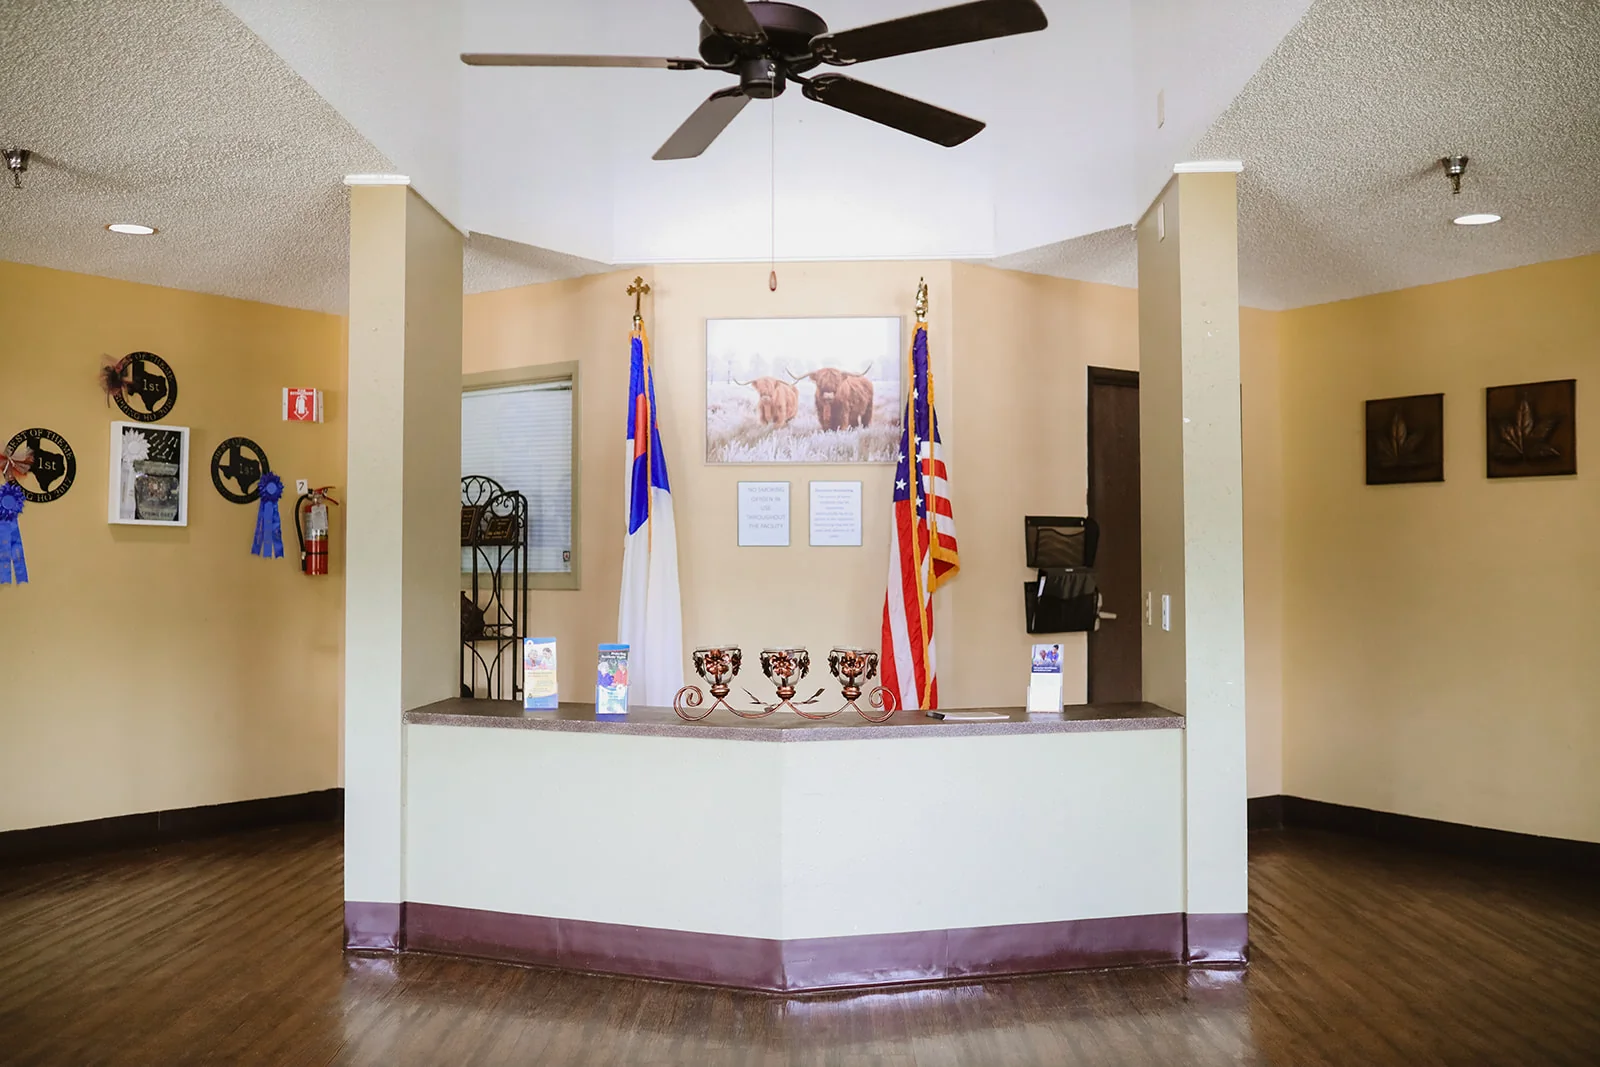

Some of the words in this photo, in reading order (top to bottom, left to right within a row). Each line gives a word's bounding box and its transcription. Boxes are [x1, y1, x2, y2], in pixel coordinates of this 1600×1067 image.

[143, 379, 160, 392] 1st
[8, 431, 28, 453] BEST
[29, 429, 43, 437] OF
[46, 430, 73, 460] THEME
[38, 457, 57, 471] 1st
[37, 494, 52, 502] HO
